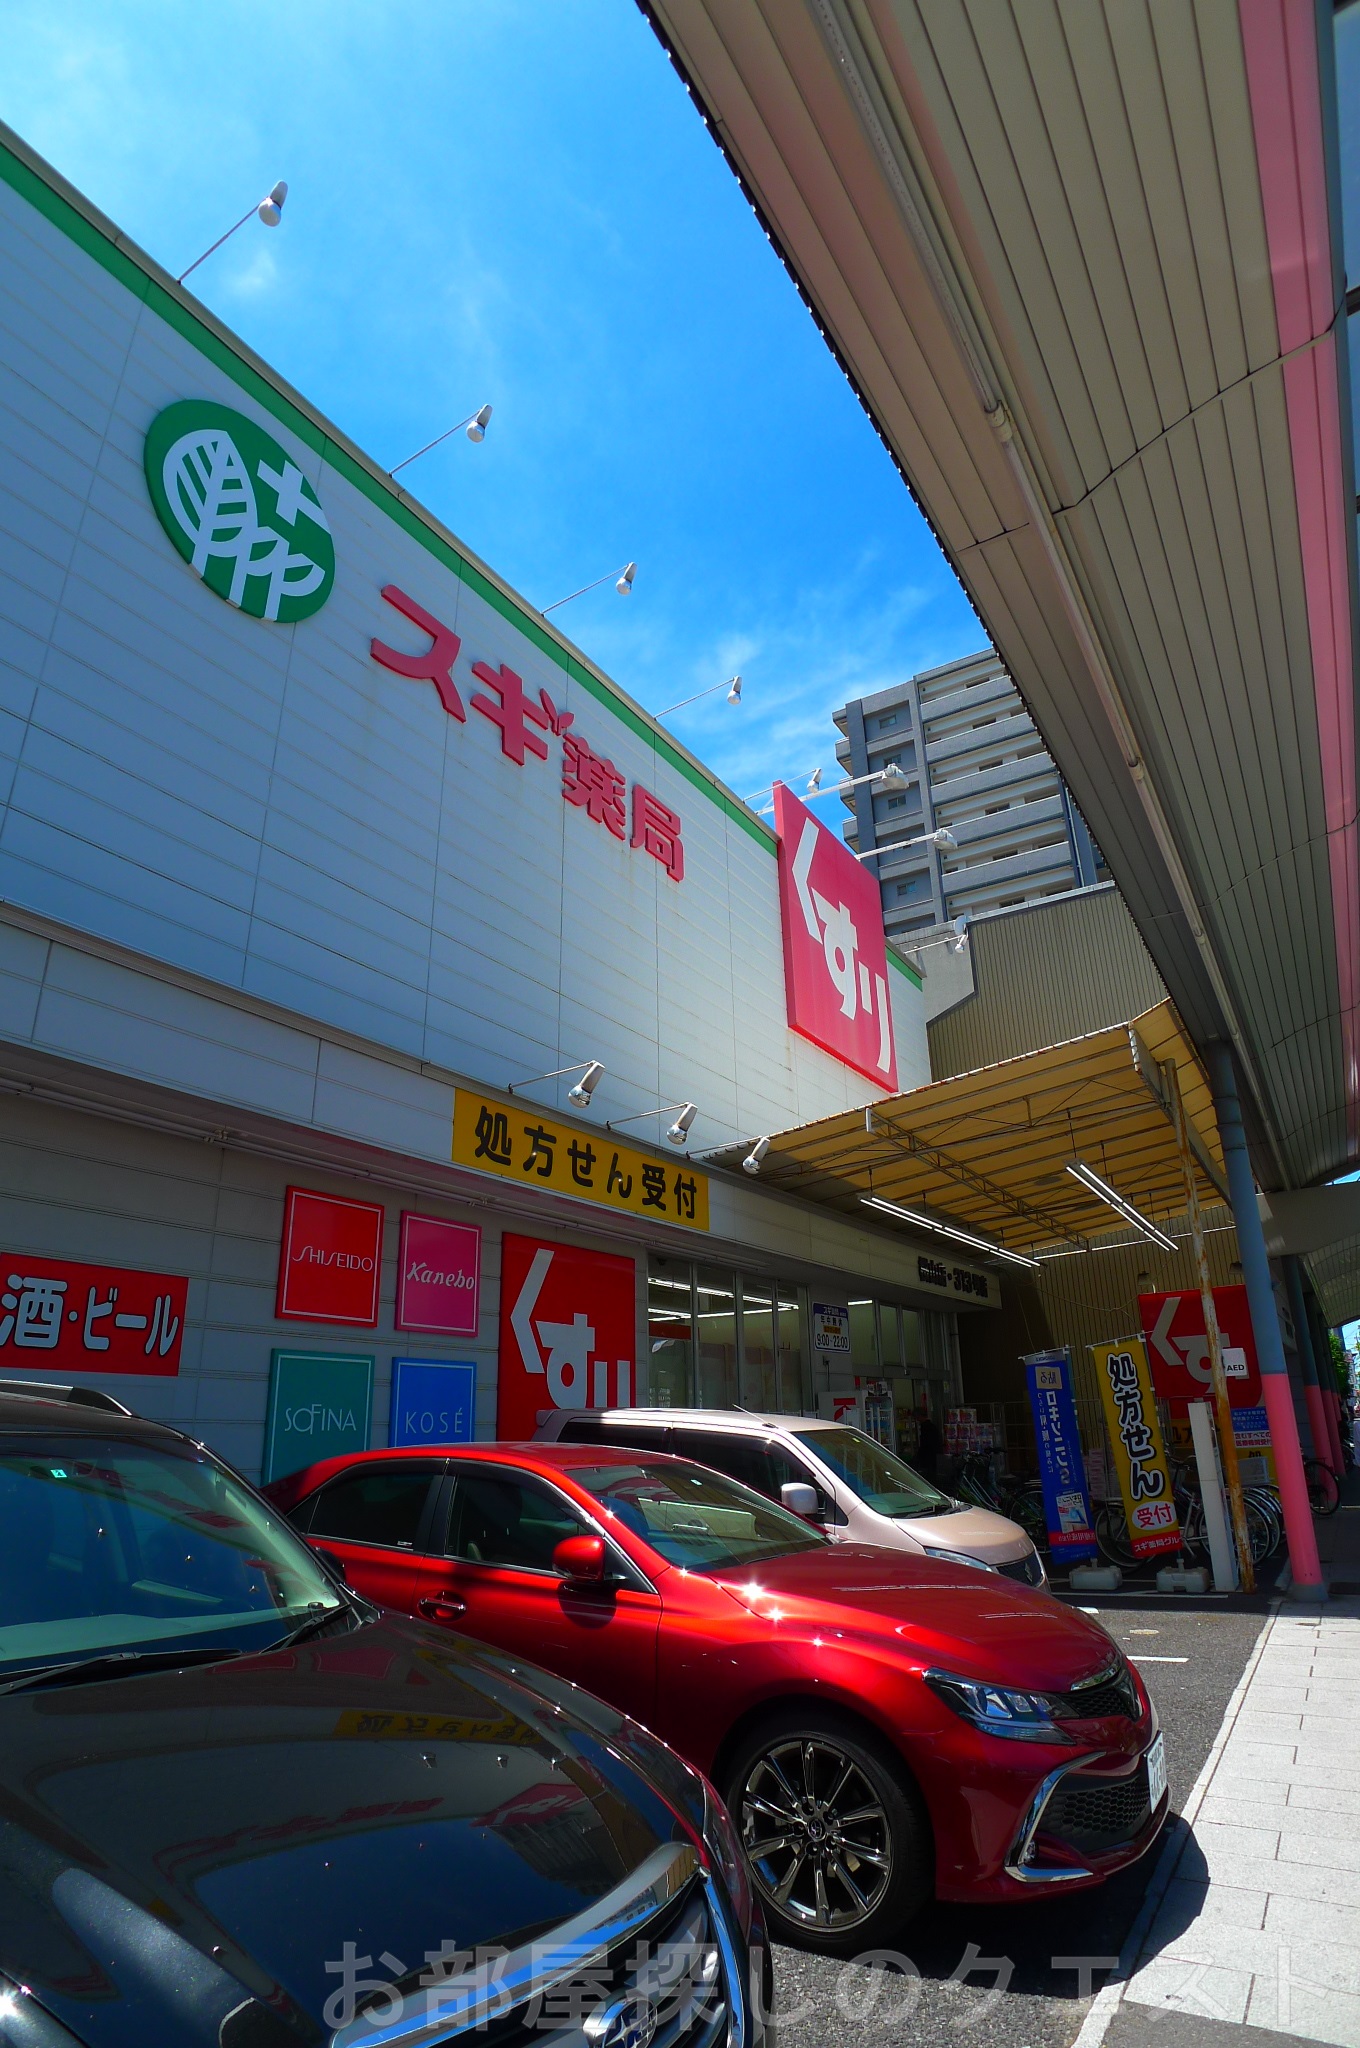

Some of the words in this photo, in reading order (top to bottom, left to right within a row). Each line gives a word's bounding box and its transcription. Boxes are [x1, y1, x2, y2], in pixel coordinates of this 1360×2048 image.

[370, 584, 684, 882] スギ薬局
[792, 817, 890, 1074] くすり
[475, 1105, 697, 1219] 処方せん受付
[292, 1245, 374, 1272] SHISEIDO
[406, 1261, 475, 1290] Kanebo
[0, 1274, 179, 1356] 酒・ビール
[510, 1248, 630, 1408] くすり
[1226, 1364, 1245, 1372] AED
[284, 1403, 357, 1435] SOFINA
[405, 1407, 463, 1434] KOSÉ
[1107, 1352, 1164, 1501] 処方せん
[1137, 1503, 1173, 1528] 受付
